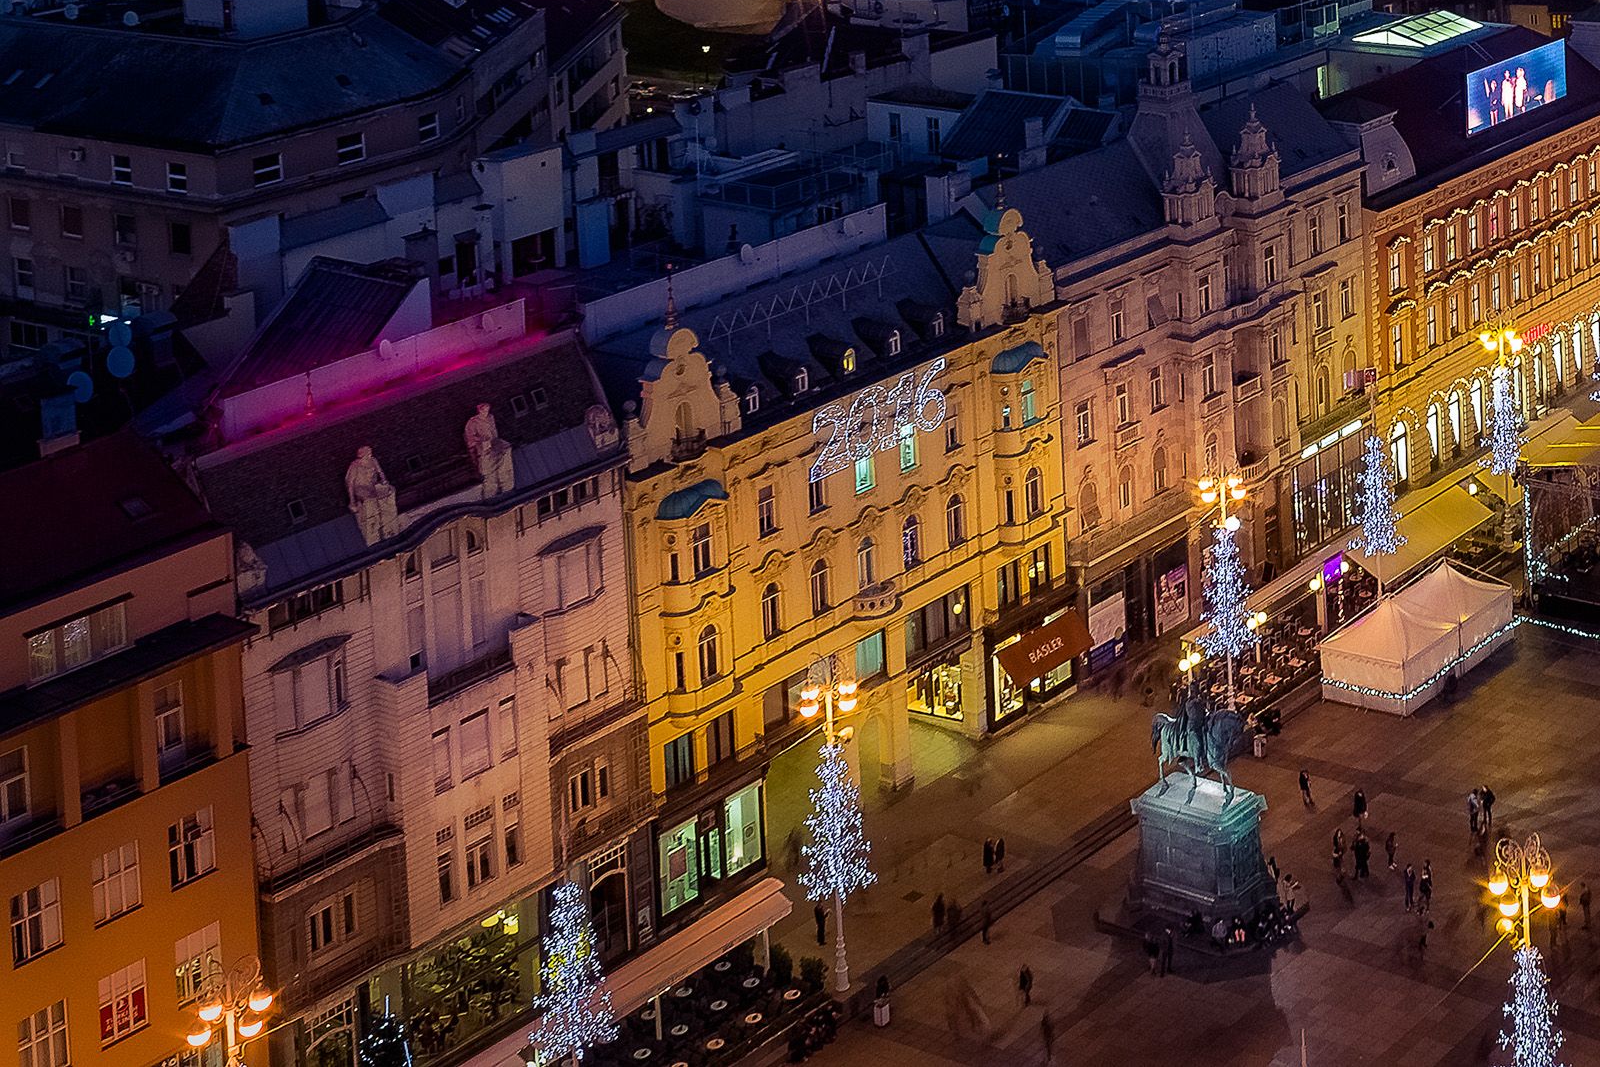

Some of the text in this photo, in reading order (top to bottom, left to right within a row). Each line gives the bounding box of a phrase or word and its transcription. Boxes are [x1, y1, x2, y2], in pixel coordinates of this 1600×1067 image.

[1521, 320, 1554, 345] Müller
[810, 358, 946, 483] 2016
[1028, 636, 1064, 664] BASLER
